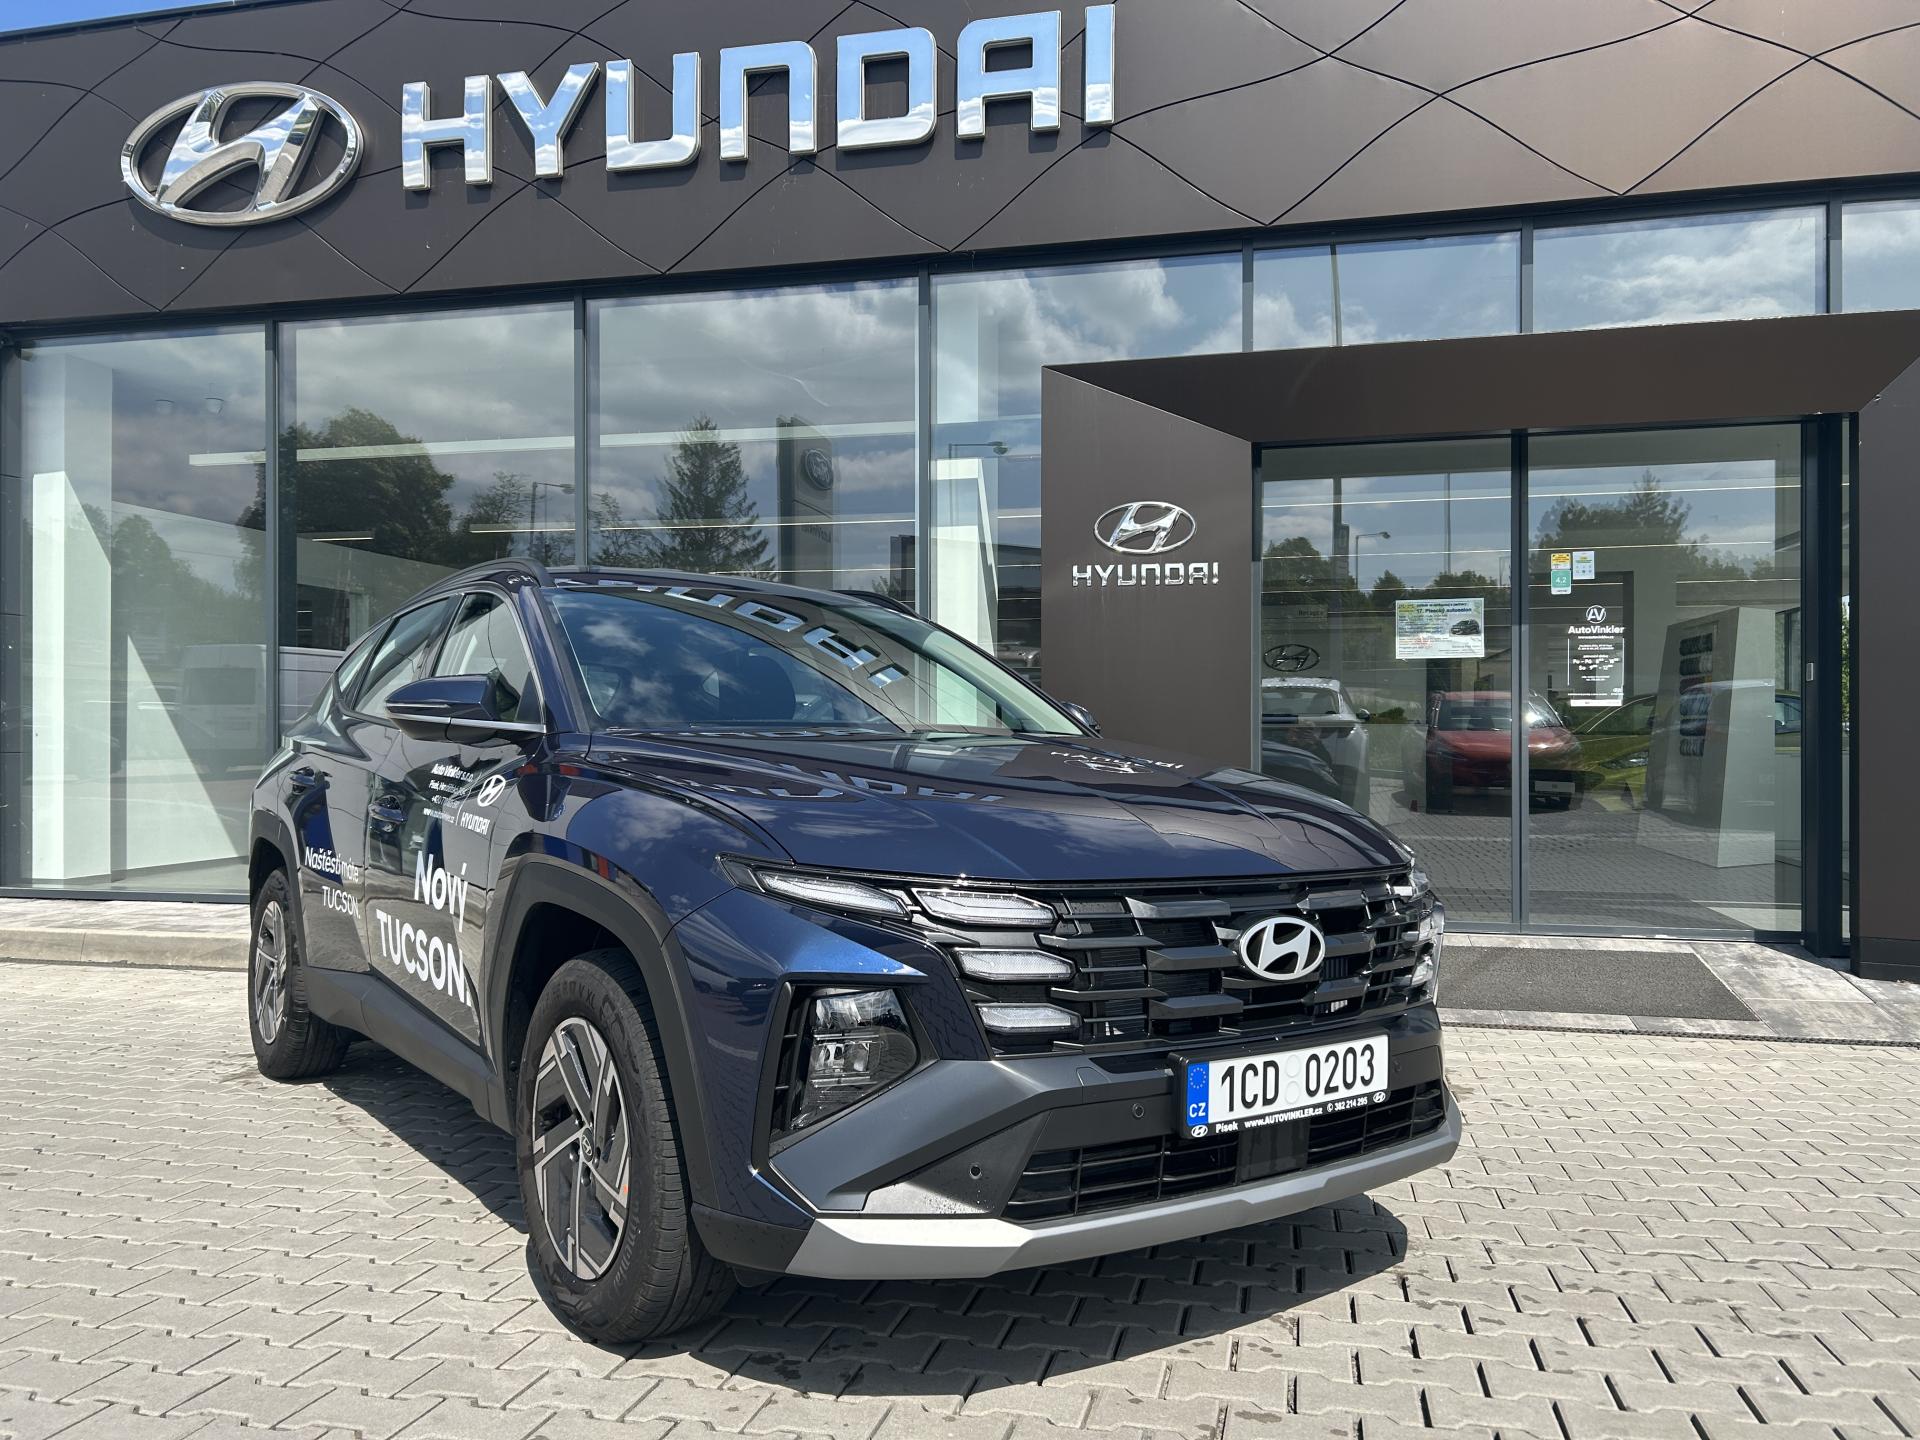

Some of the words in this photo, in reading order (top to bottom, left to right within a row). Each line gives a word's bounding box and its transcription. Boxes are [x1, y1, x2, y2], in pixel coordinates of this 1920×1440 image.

[402, 3, 1115, 191] HYUNDAI
[1072, 562, 1219, 587] HYUNDAI
[1568, 625, 1625, 634] AutoVinkler
[460, 812, 491, 836] HYUNDAI
[322, 885, 361, 919] TUCSON.
[414, 850, 468, 933] Nový
[376, 908, 472, 1008] TUCSON.
[1221, 1059, 1280, 1113] 1CD
[1305, 1043, 1375, 1098] 0203
[1189, 1103, 1206, 1119] CZ
[1215, 1120, 1239, 1134] Písek
[1244, 1107, 1323, 1129] www.AUTOVINKLER.cz
[1334, 1101, 1345, 1112] 382
[1345, 1099, 1357, 1109] 214
